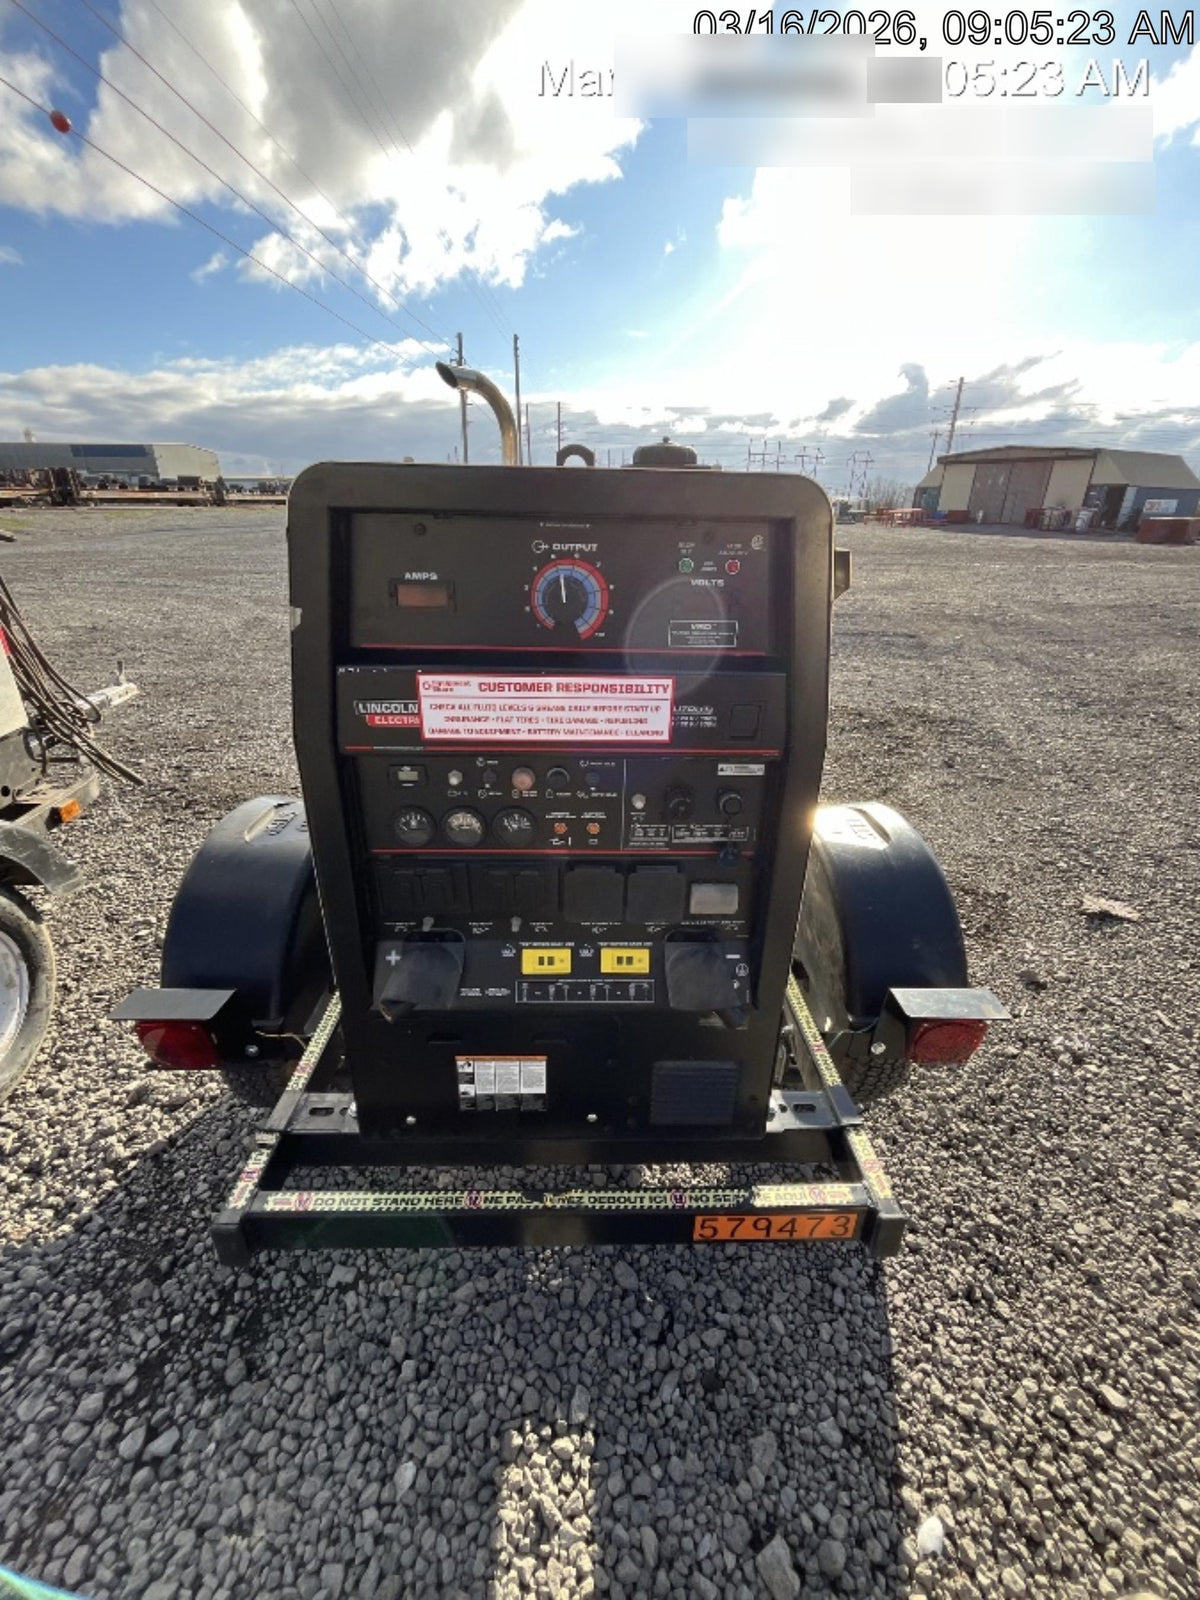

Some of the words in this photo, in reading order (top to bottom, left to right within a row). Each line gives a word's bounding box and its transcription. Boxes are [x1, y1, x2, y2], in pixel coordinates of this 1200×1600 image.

[552, 543, 598, 552] OUTPUT
[404, 571, 438, 580] AMPS
[691, 579, 725, 587] VOLTS
[478, 682, 552, 693] CUSTOMER
[556, 682, 670, 694] RESPONSIBILITY
[358, 703, 419, 714] LINCOLN
[313, 1196, 335, 1206] DO
[338, 1196, 369, 1206] NOT
[372, 1196, 426, 1206] STAND
[429, 1195, 464, 1206] HERE
[588, 1195, 645, 1205] DEBOUT
[697, 1215, 851, 1239] 579473
